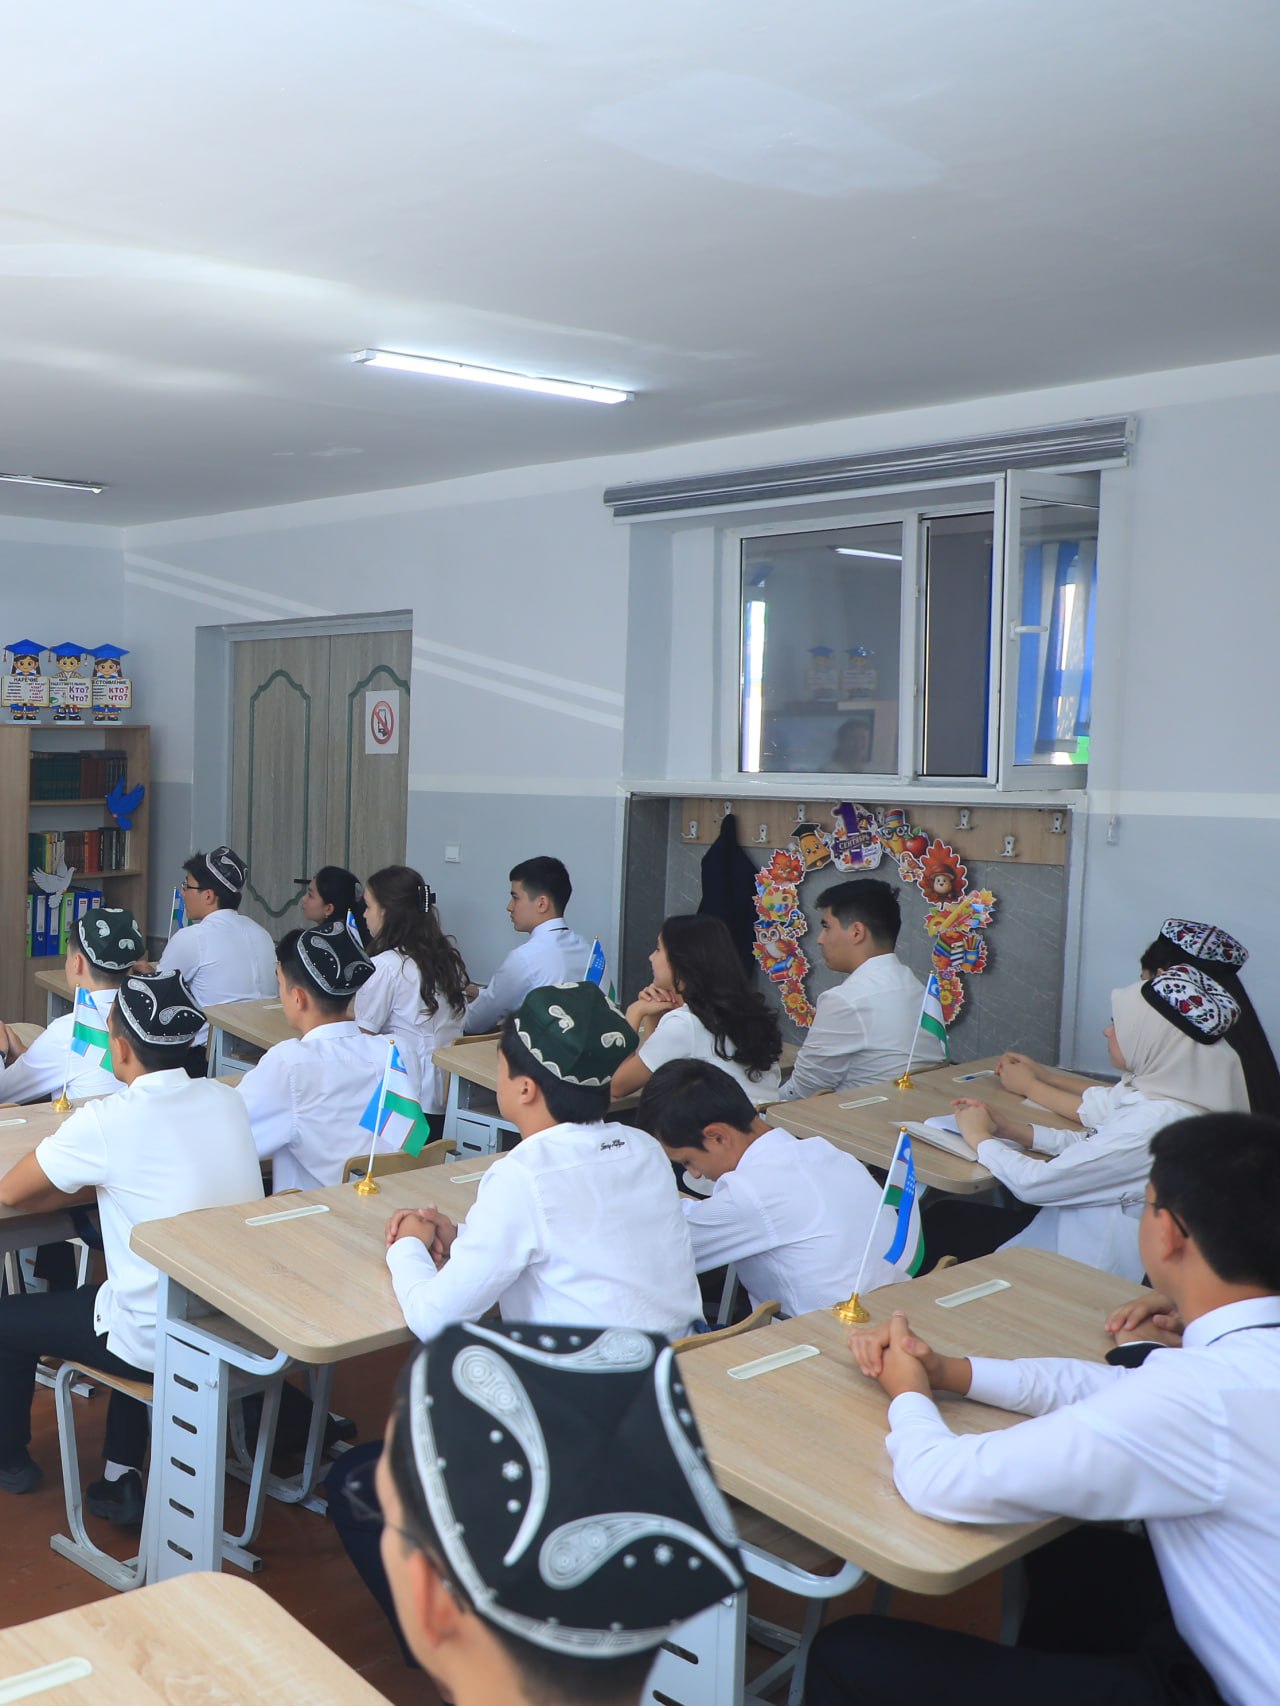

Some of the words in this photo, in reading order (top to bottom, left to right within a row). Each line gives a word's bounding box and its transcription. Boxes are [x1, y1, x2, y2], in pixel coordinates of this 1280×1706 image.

[69, 686, 89, 694] Кто?
[69, 694, 89, 702] Что?
[839, 833, 870, 850] СЕНТЯБРЬ
